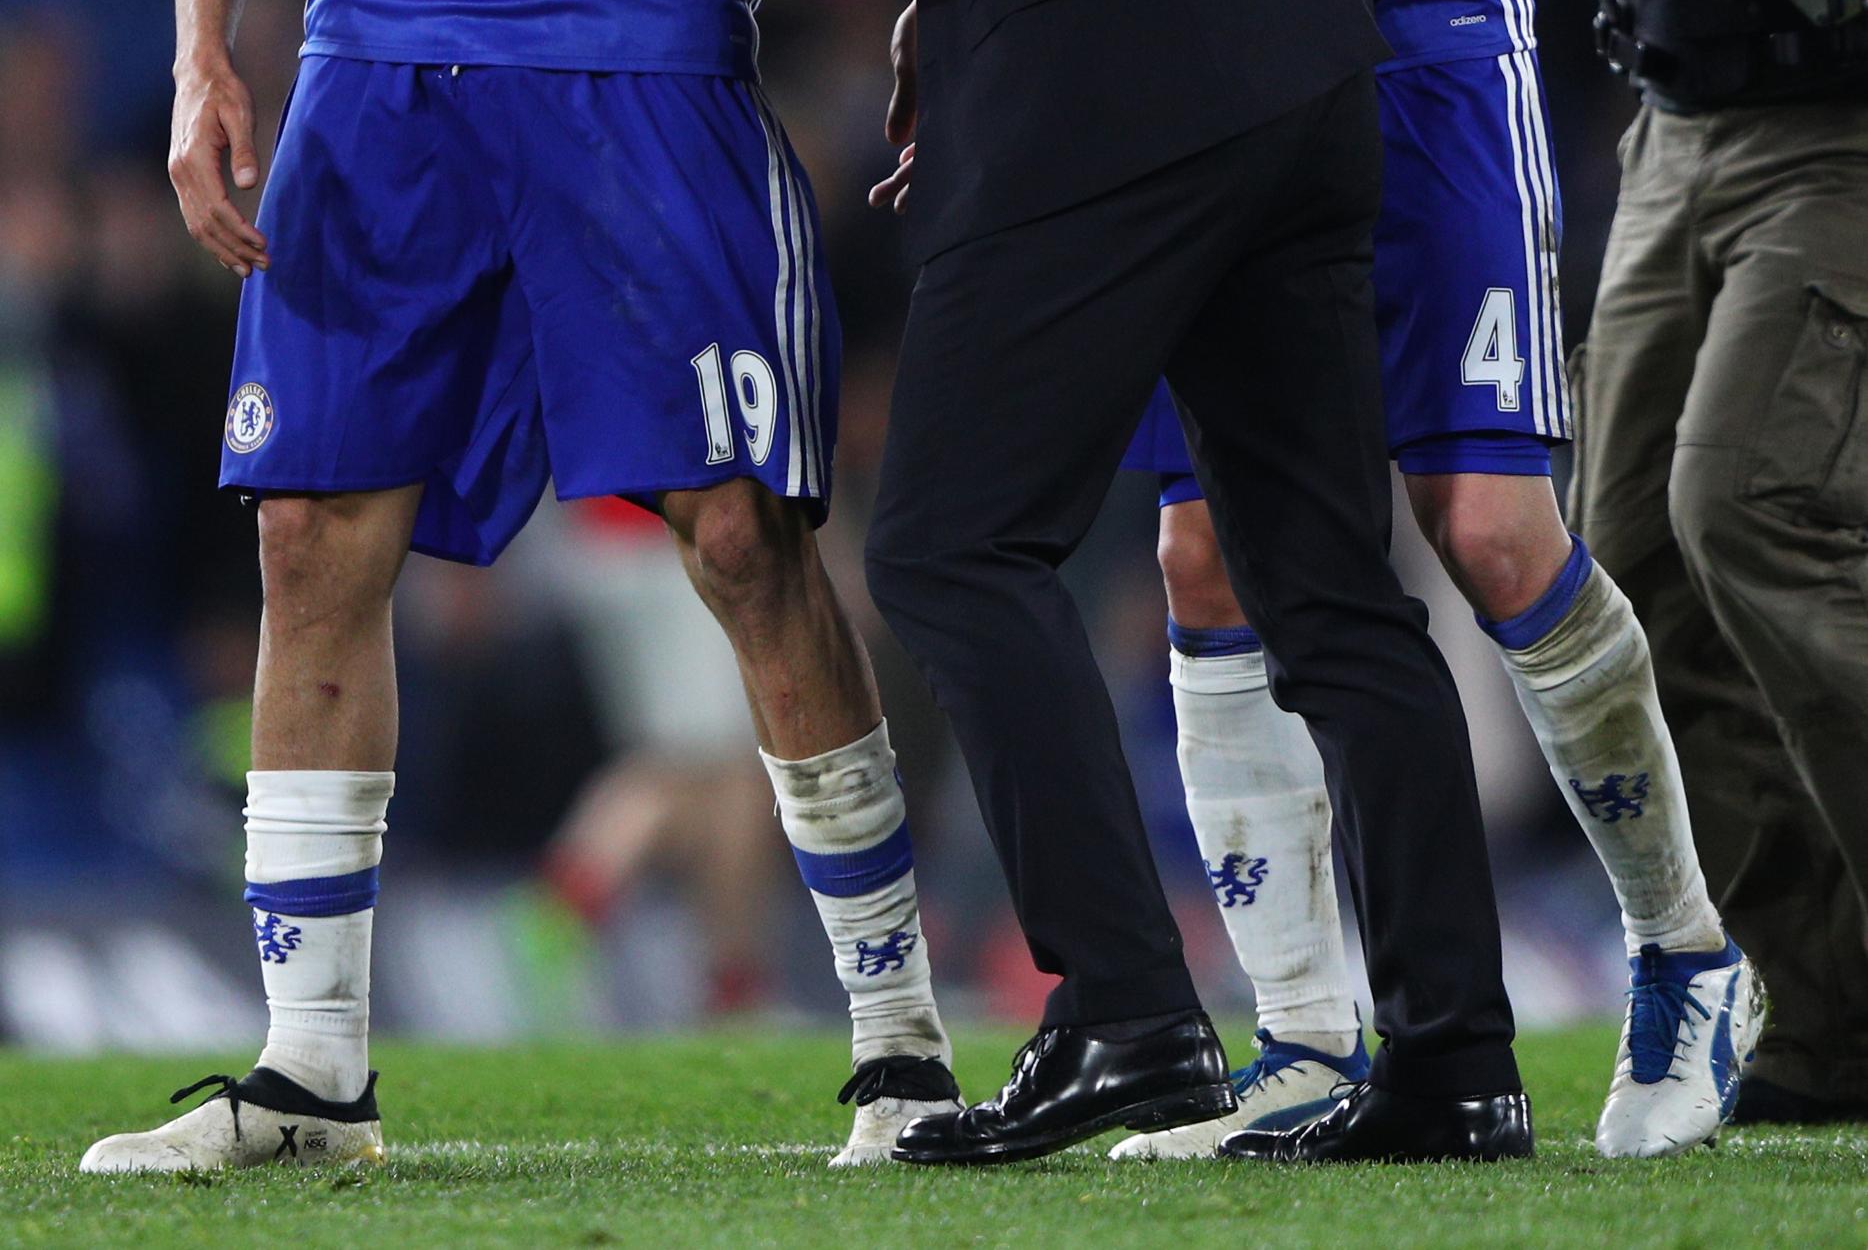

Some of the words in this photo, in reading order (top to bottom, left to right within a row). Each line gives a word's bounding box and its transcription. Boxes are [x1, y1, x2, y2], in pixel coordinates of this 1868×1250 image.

[1450, 14, 1487, 27] adizero
[1460, 287, 1525, 412] 4
[236, 385, 265, 401] CHELSEA
[690, 342, 778, 466] 19
